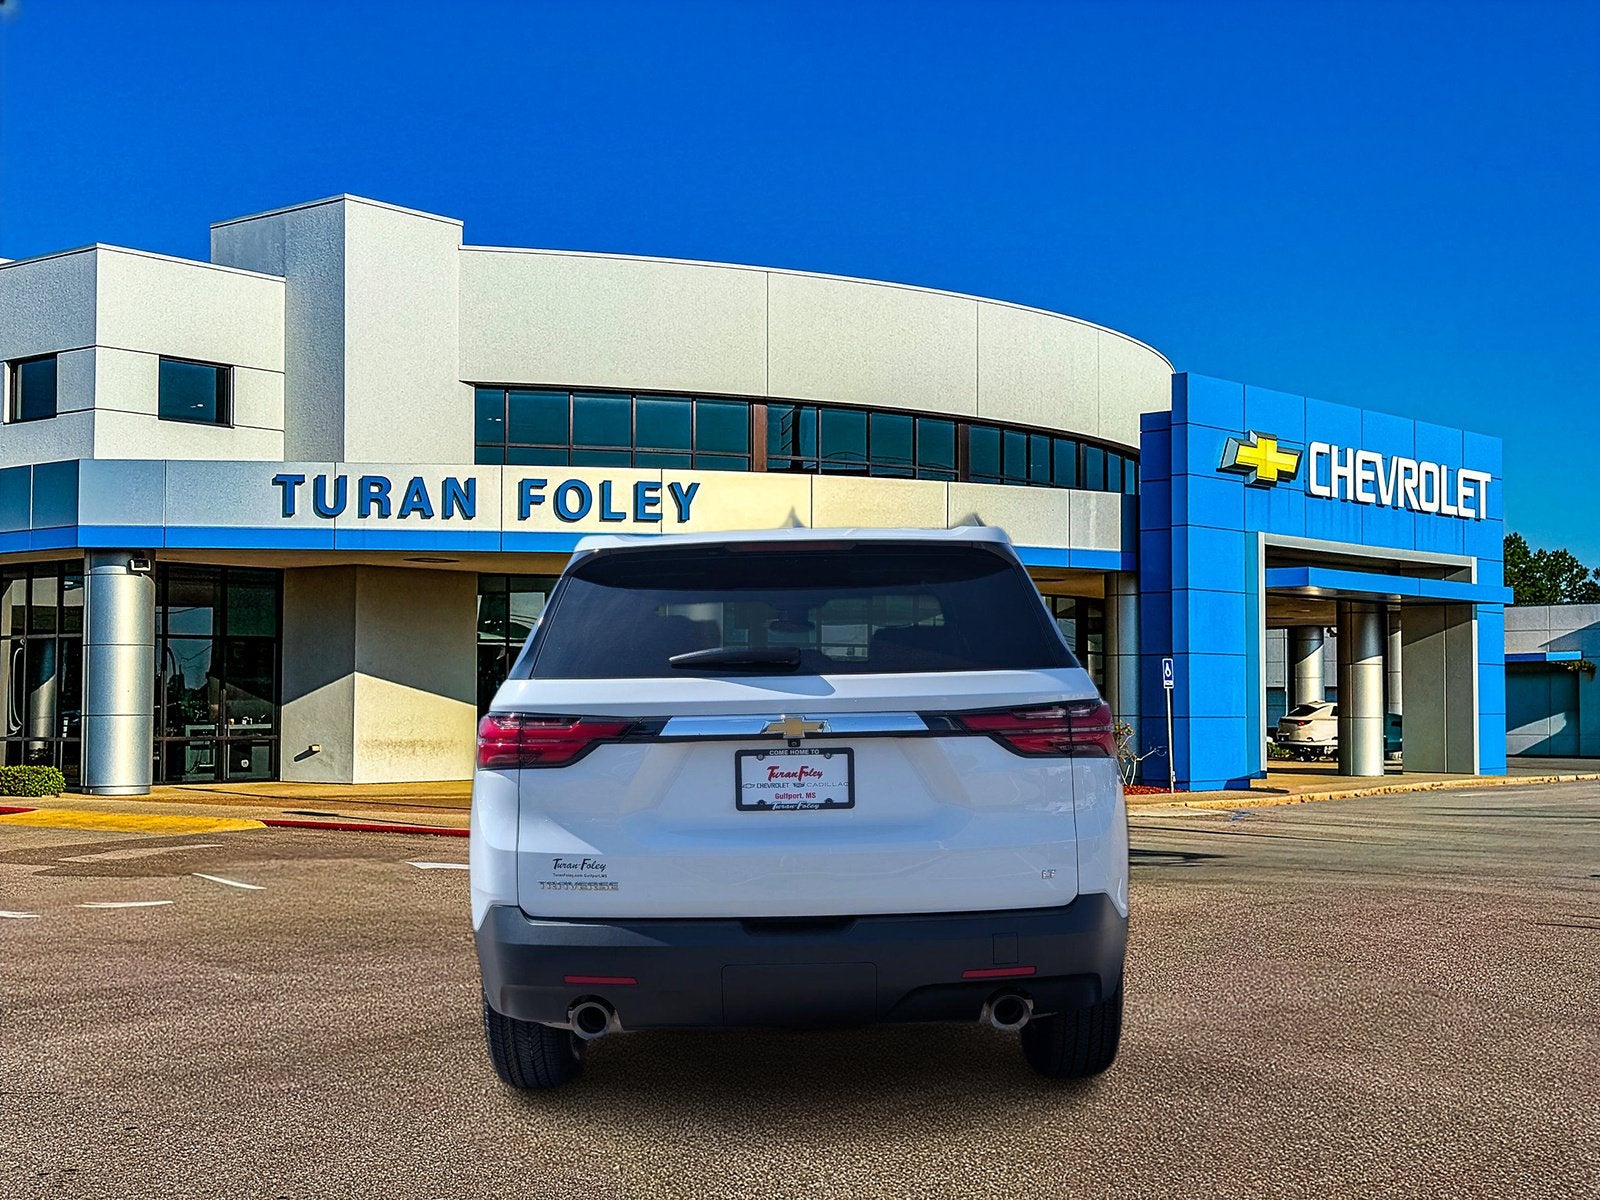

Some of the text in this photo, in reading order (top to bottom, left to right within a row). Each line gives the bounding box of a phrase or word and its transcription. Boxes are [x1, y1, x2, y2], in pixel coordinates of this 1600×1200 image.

[272, 474, 700, 523] TURAN FOLEY
[1308, 441, 1492, 520] CHEVROLET
[538, 881, 619, 891] TRAVERSE
